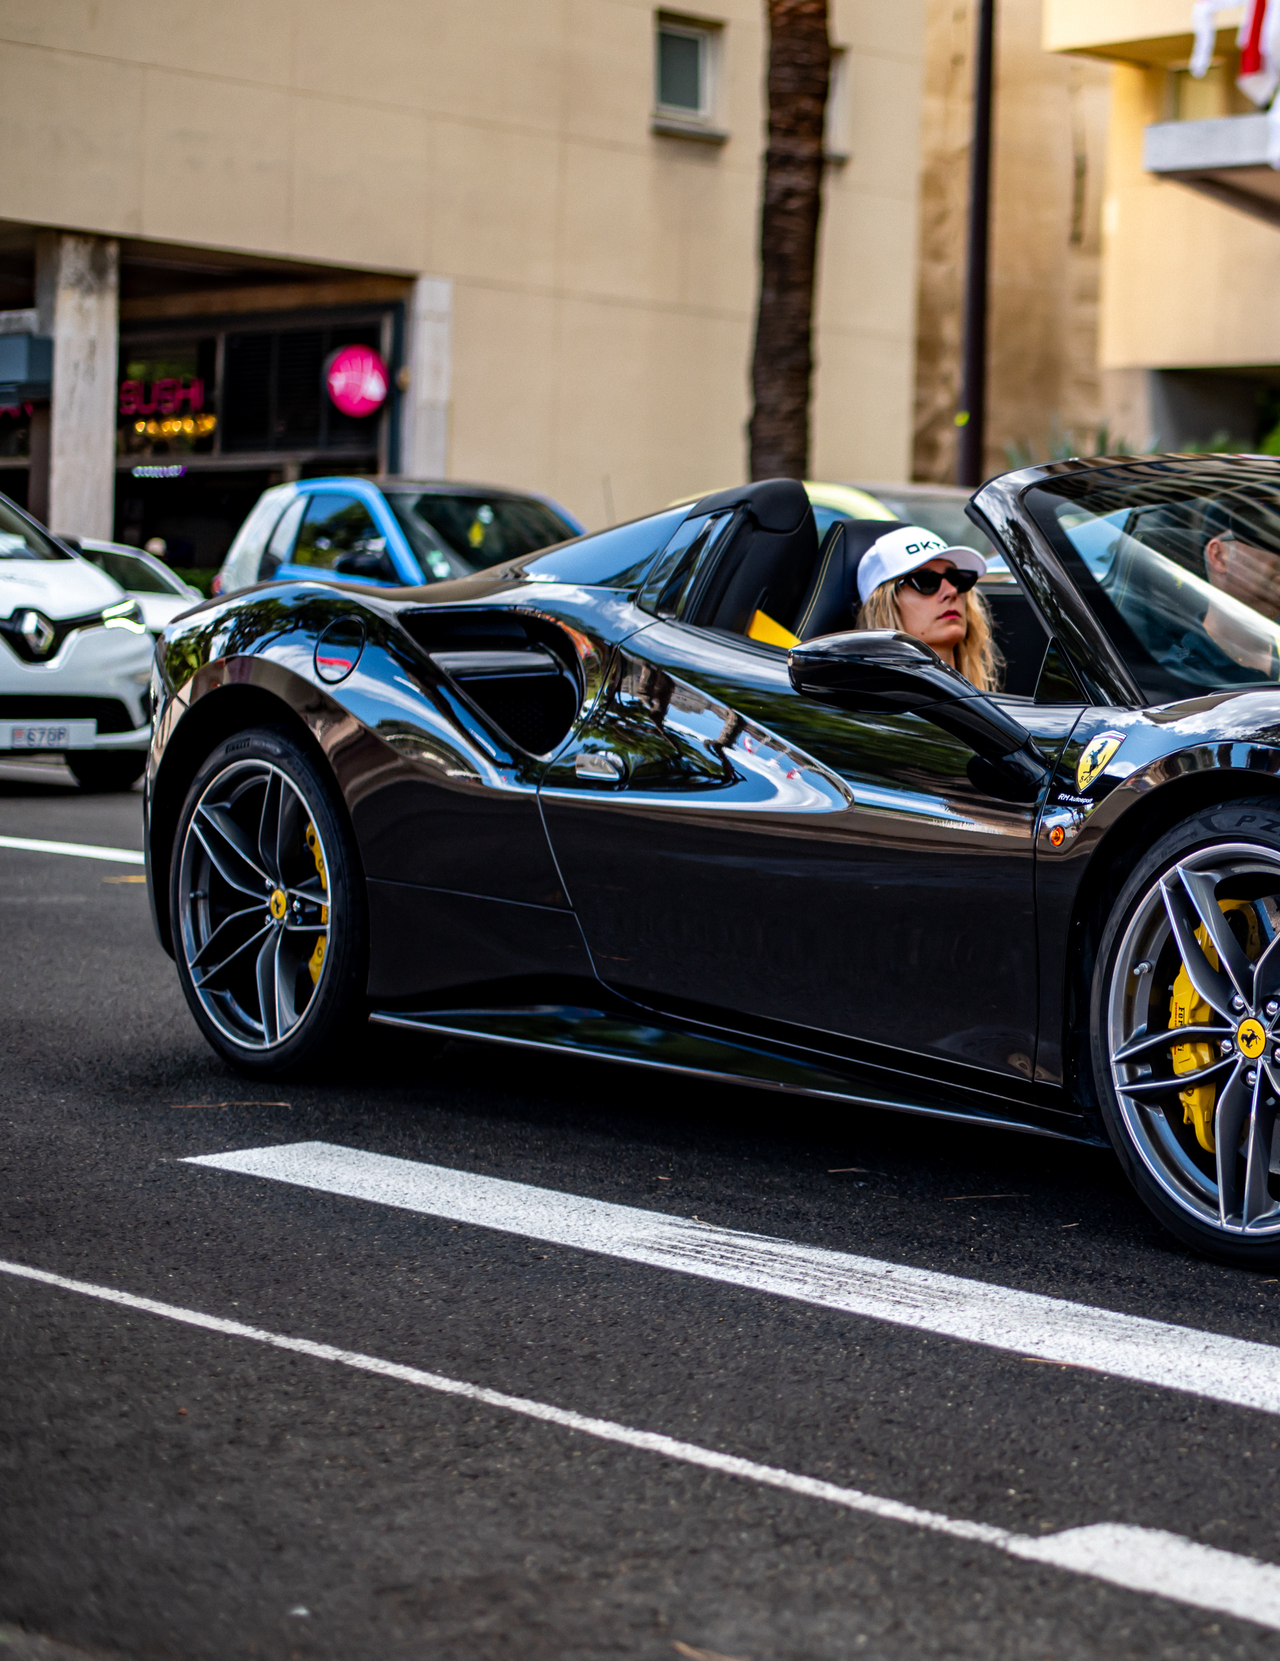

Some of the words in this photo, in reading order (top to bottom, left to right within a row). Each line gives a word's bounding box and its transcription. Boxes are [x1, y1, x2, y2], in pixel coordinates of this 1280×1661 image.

[120, 378, 204, 416] SUSHI
[905, 540, 947, 555] OKT
[1057, 793, 1070, 801] RM
[1235, 814, 1257, 827] P
